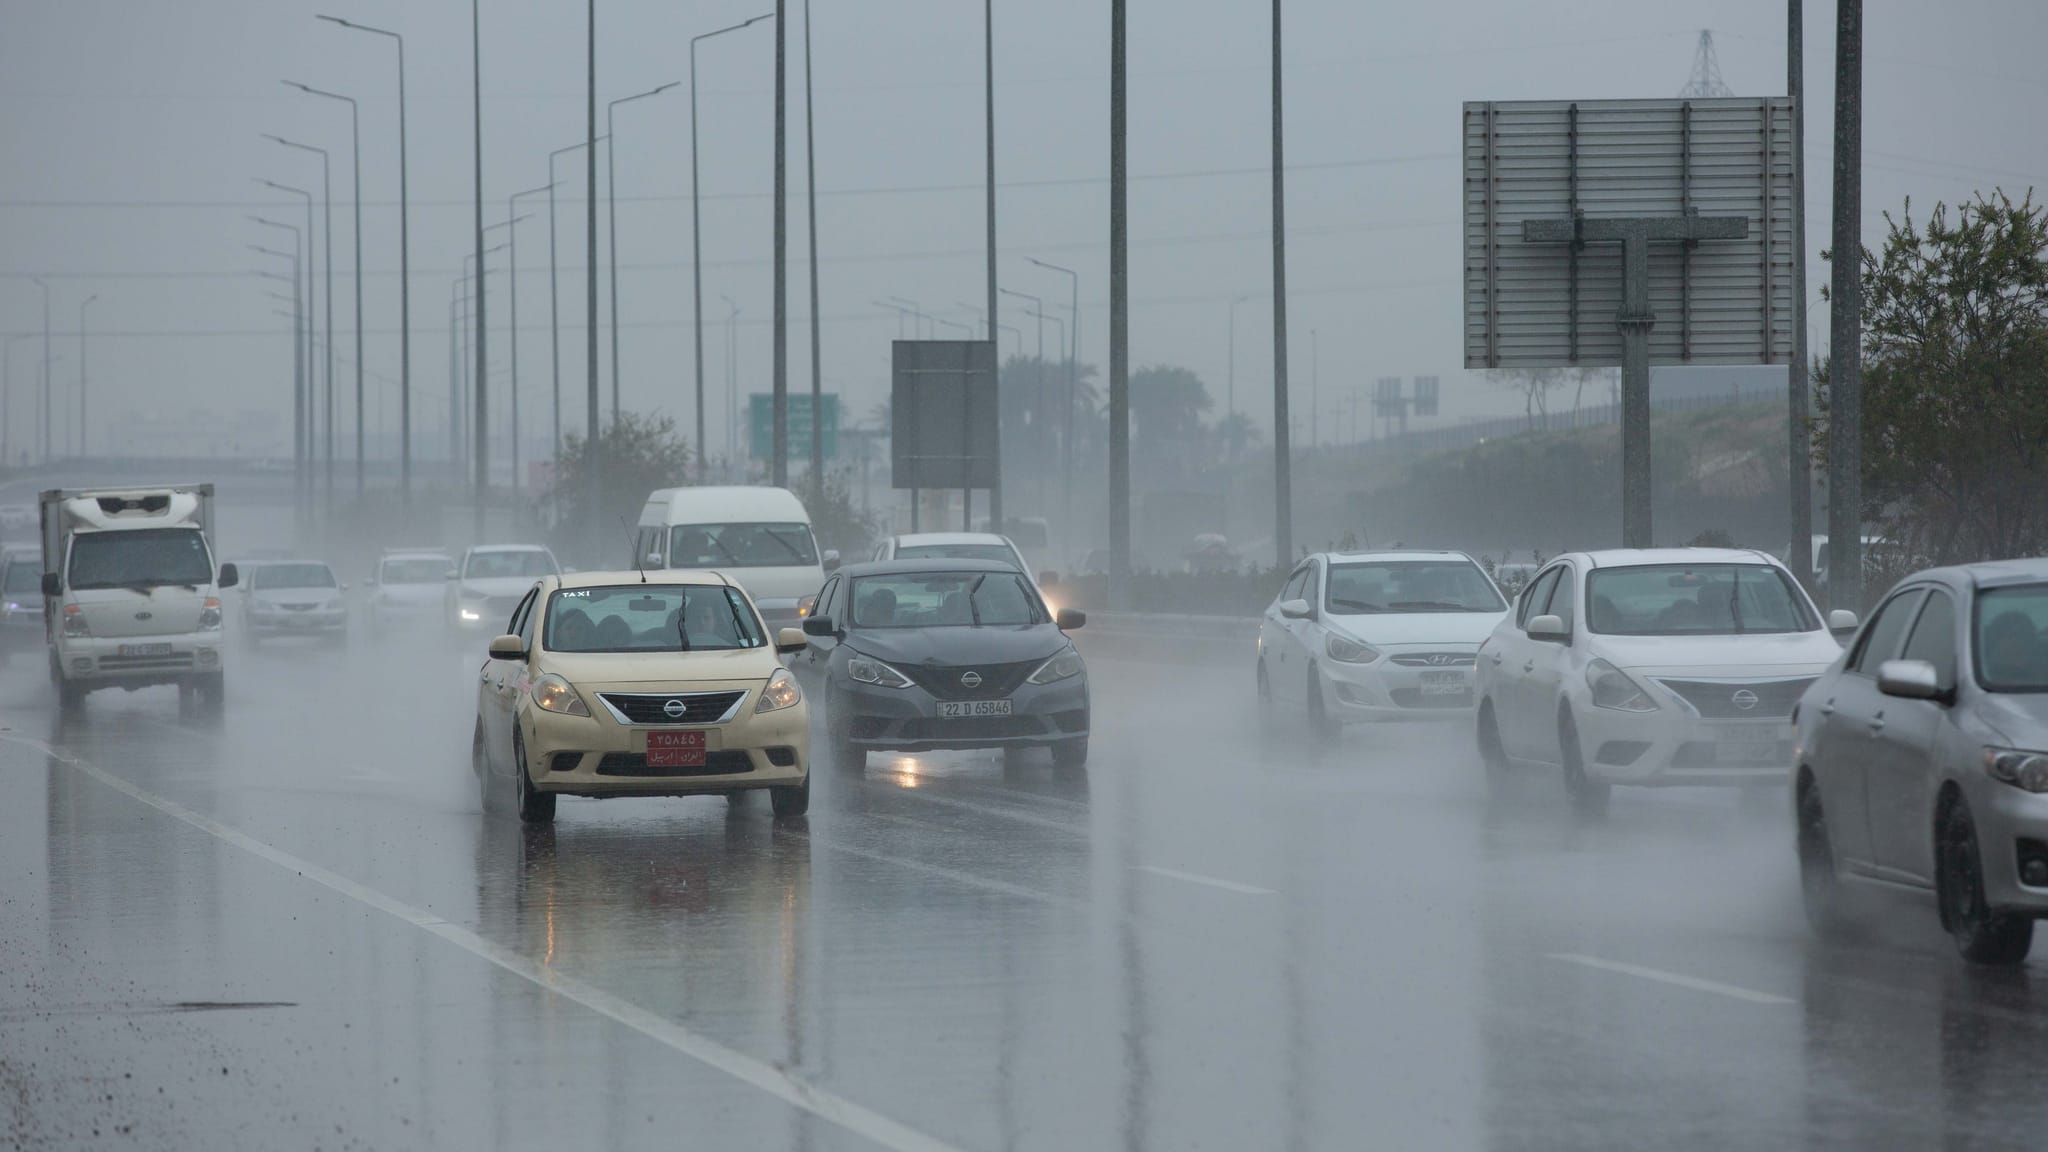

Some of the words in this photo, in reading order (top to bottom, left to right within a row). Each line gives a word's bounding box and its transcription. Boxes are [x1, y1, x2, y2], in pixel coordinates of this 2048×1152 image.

[562, 590, 590, 598] TAXI
[945, 703, 960, 716] 22
[975, 701, 1009, 714] 65846
